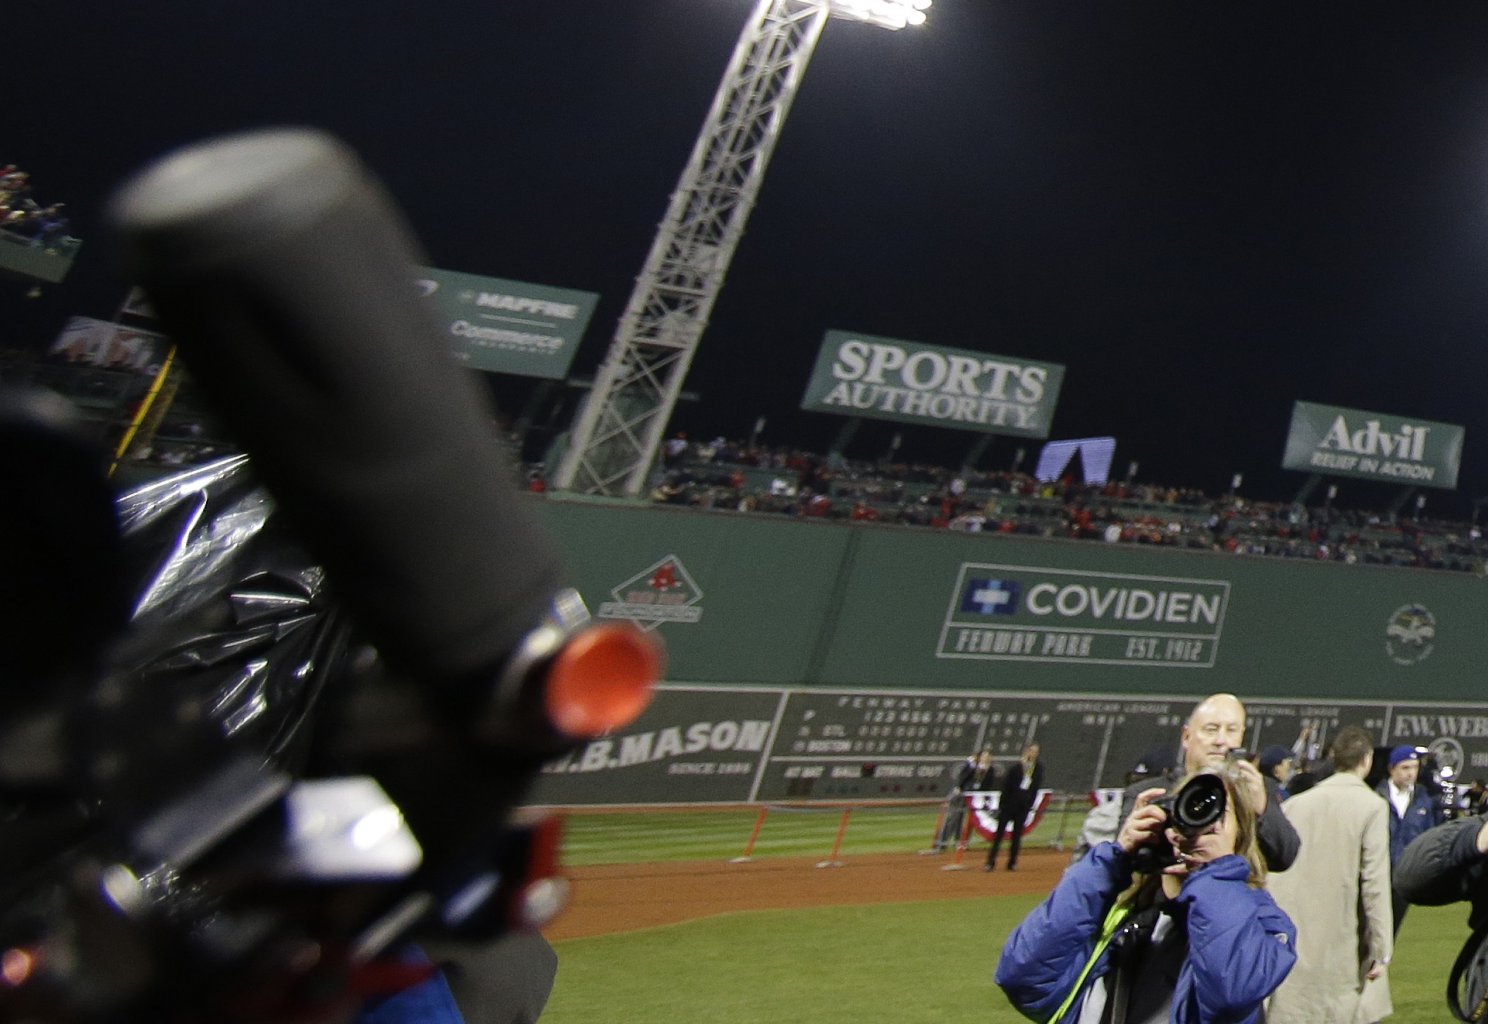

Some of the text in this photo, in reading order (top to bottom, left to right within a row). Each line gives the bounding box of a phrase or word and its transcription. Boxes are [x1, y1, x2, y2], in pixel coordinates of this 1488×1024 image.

[832, 339, 1047, 404] SPORTS
[822, 381, 1038, 429] AUTHORITY
[1319, 414, 1431, 461] Advil
[1310, 451, 1435, 482] RELIEF IN ACTION
[1025, 582, 1221, 625] COVIDIEN
[955, 628, 1038, 654] FENWAY
[1041, 633, 1094, 657] PARK
[1125, 637, 1162, 660] EST.
[838, 695, 990, 711] FENWAY PARK
[543, 720, 772, 774] .B.MASON
[1394, 714, 1437, 737] F.W.
